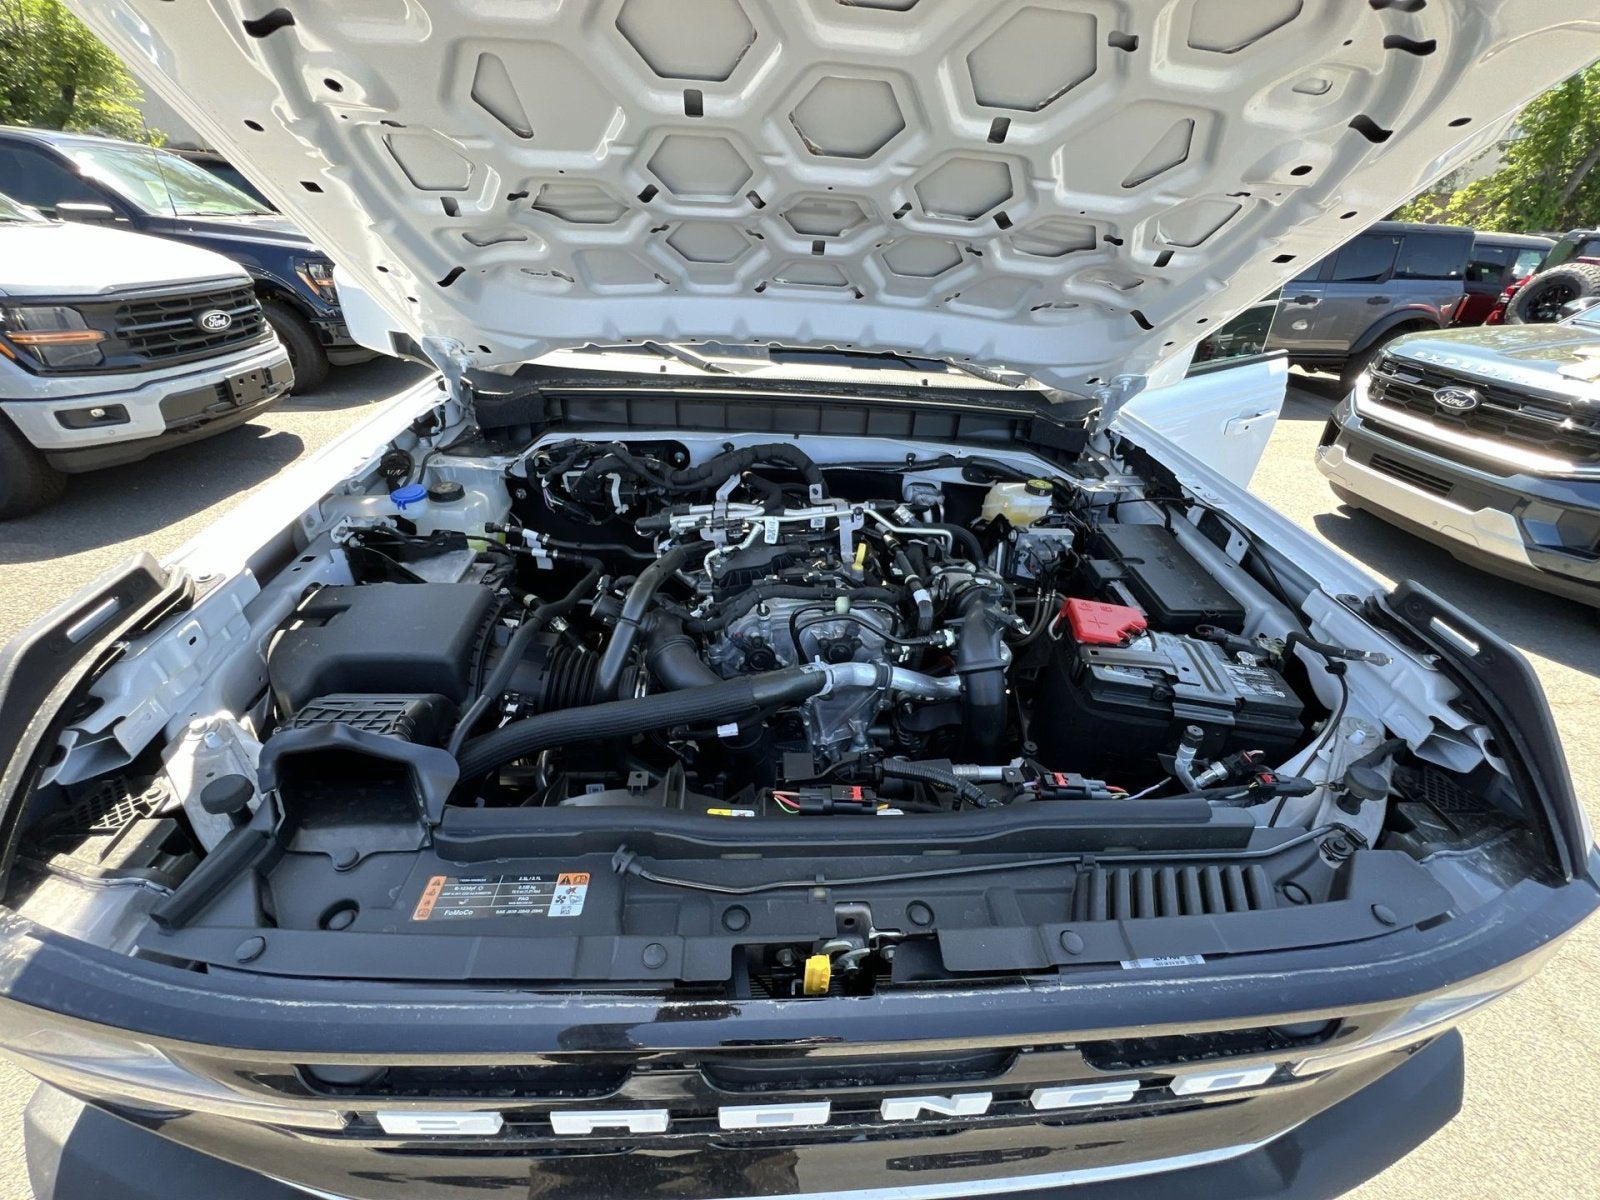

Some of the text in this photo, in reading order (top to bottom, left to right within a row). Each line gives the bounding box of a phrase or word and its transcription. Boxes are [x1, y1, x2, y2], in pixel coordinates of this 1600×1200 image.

[208, 315, 227, 327] Ford
[1440, 391, 1469, 407] Ford
[376, 1063, 1277, 1135] BRONCO
